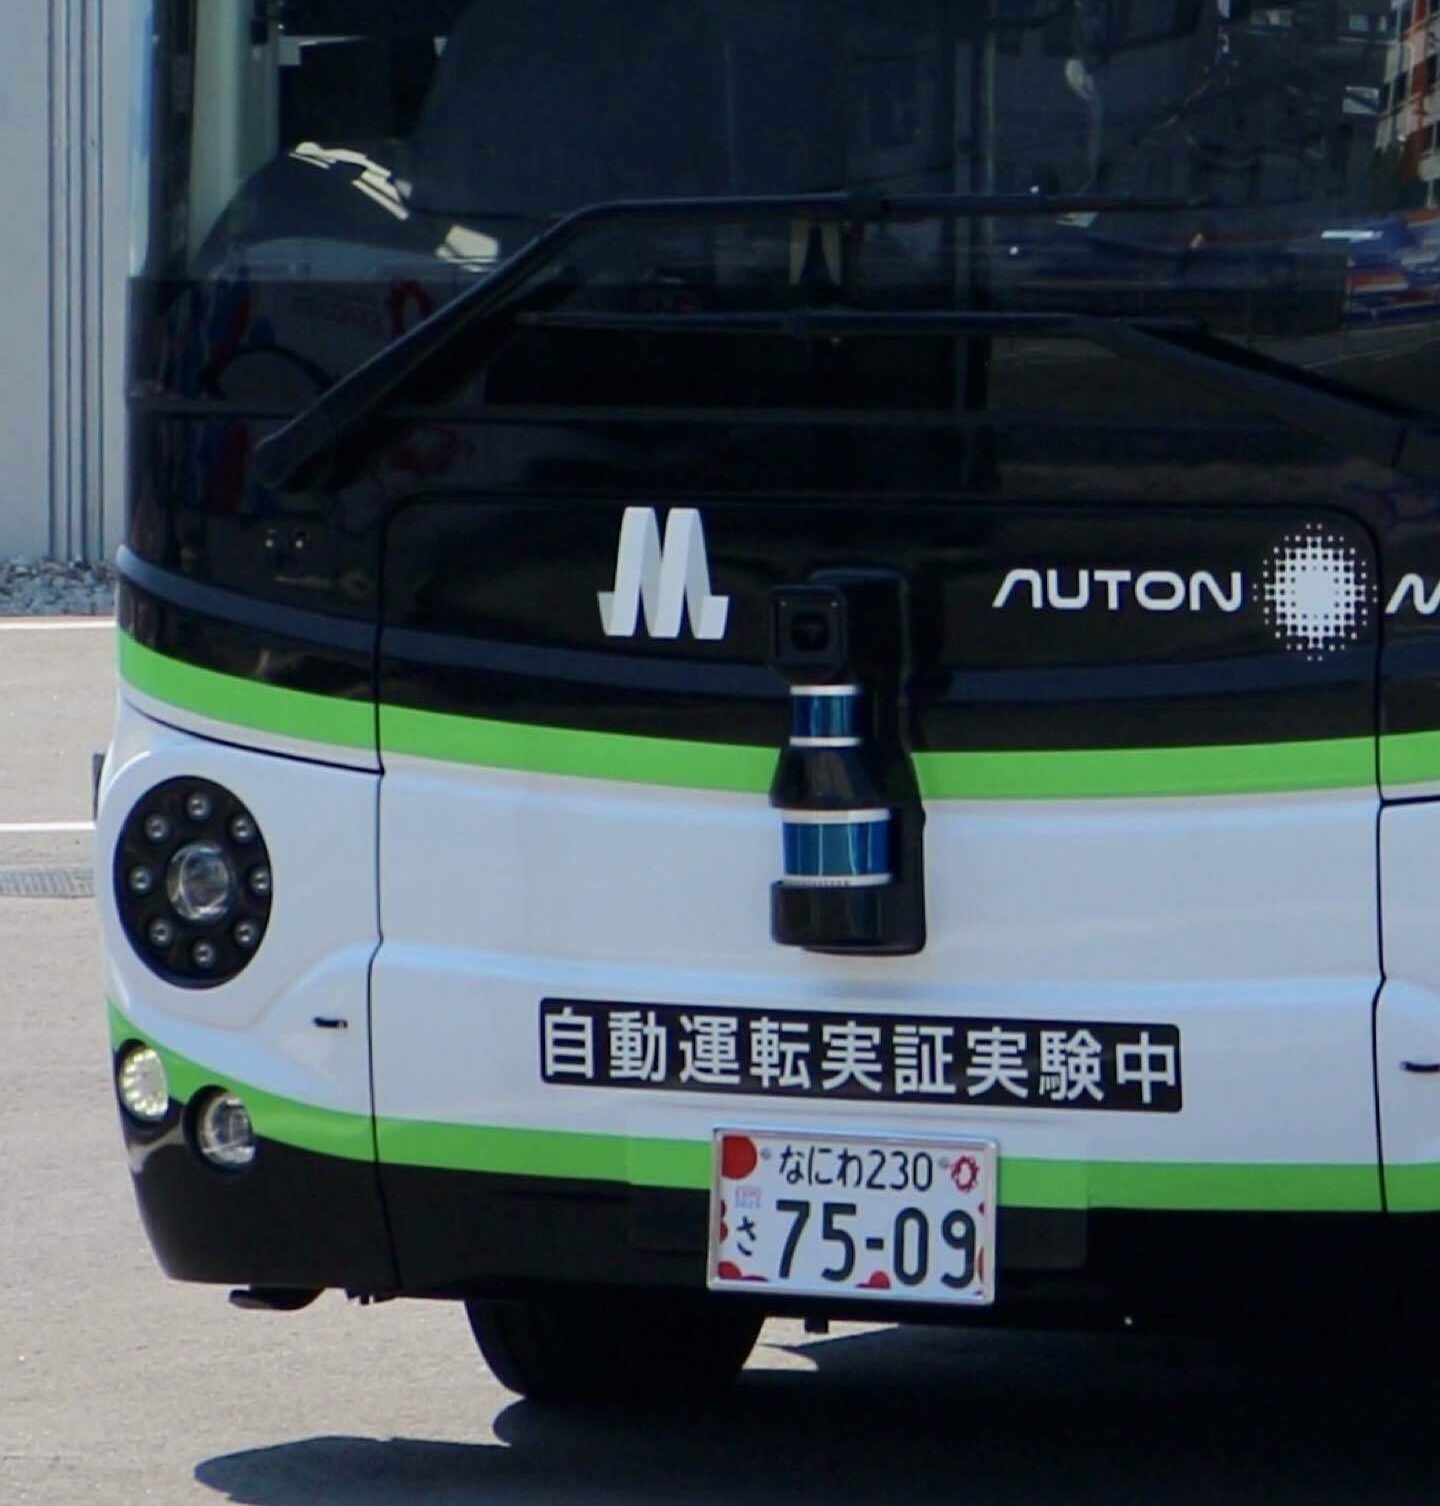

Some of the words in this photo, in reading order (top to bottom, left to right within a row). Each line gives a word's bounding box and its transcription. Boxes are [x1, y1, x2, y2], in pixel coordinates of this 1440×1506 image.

[544, 1006, 1177, 1104] 自動運転実証実験中
[736, 1215, 757, 1256] さ
[775, 1199, 977, 1289] 75-09
